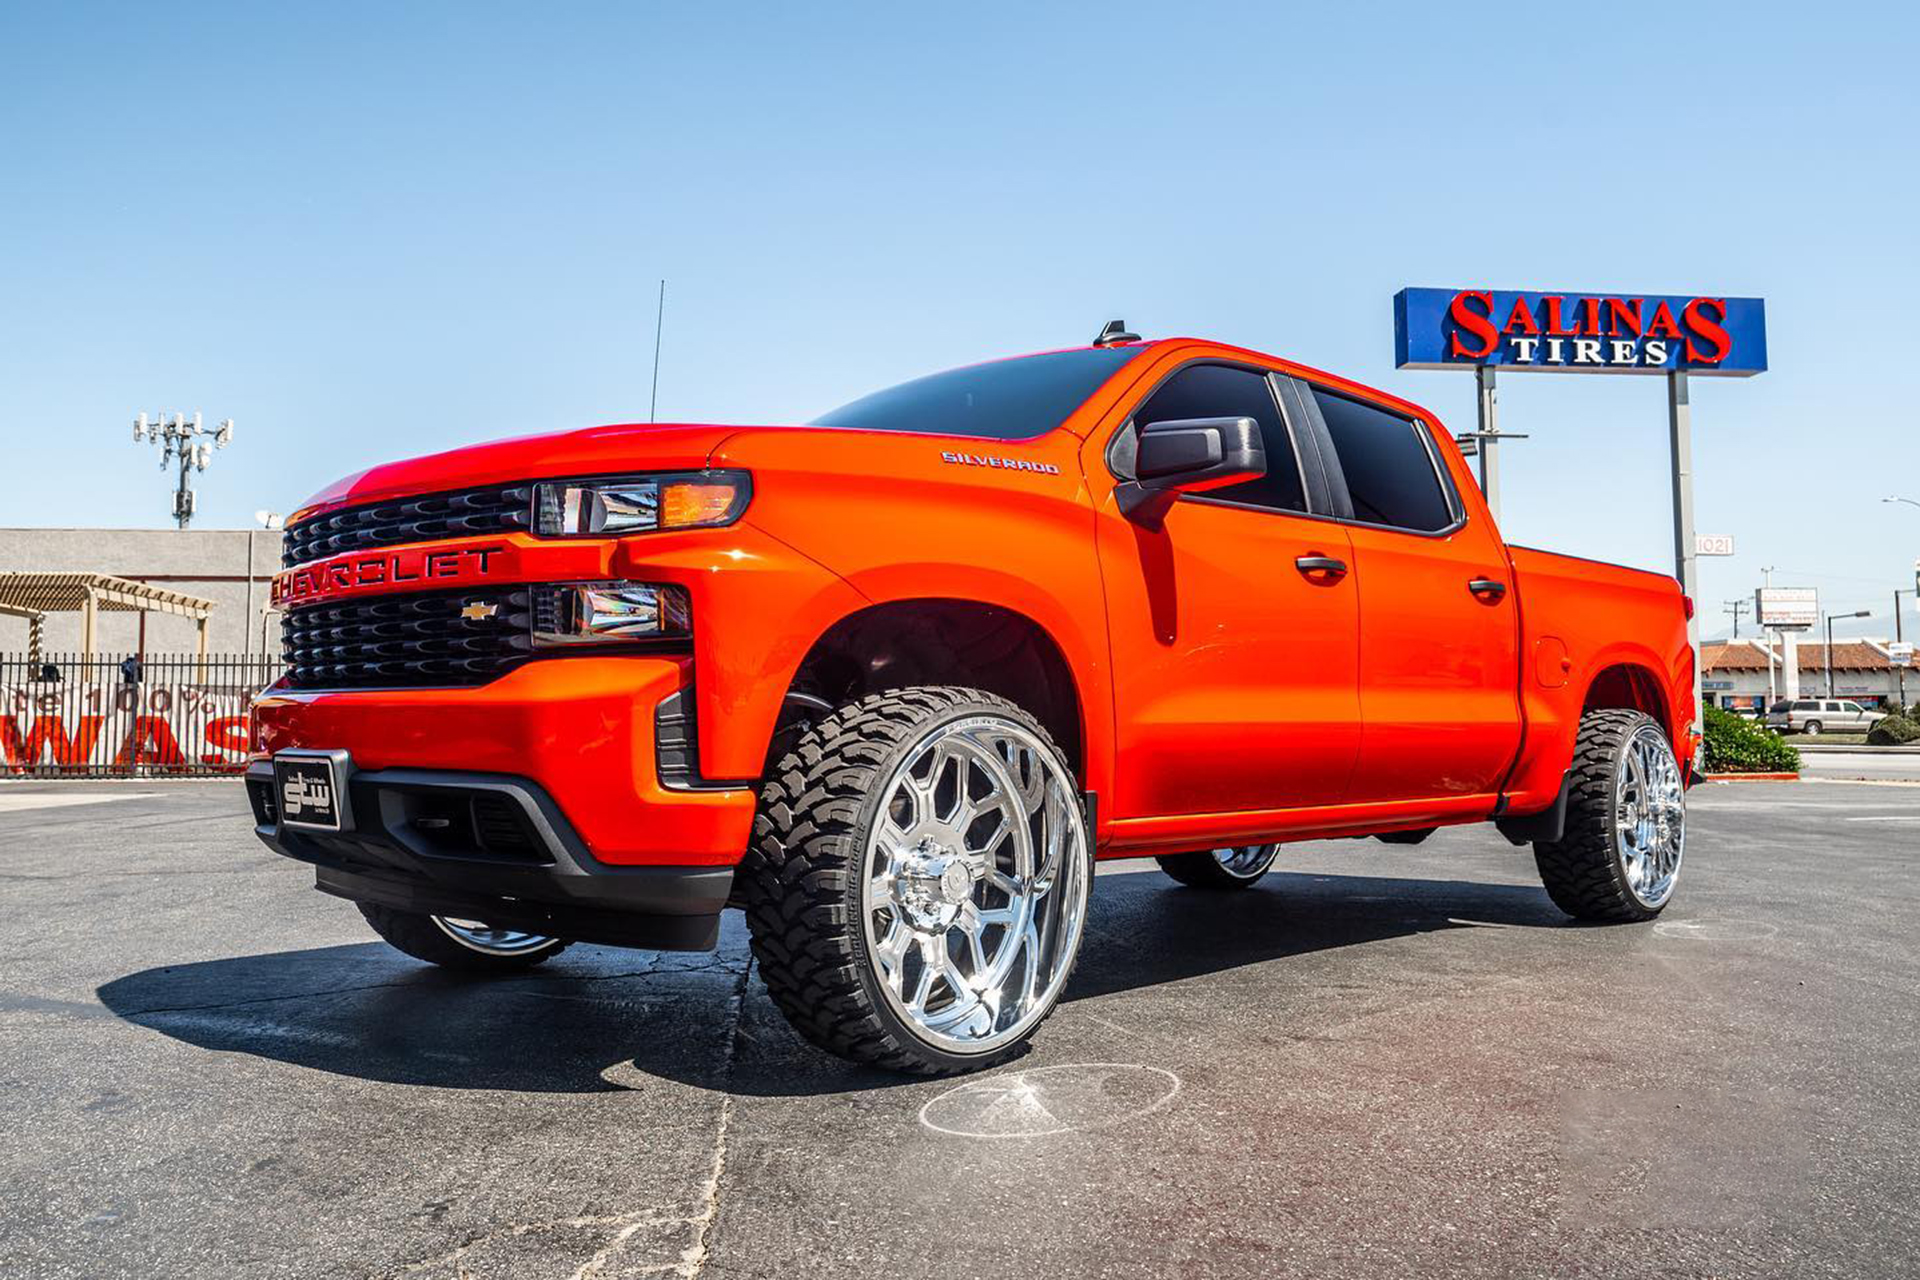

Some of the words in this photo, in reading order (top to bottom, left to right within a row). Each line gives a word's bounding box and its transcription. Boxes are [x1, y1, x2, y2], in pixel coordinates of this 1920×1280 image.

[1450, 290, 1732, 364] SALINAS
[1510, 337, 1668, 365] TIRES
[941, 451, 1059, 475] SILVERADO
[1698, 538, 1729, 554] 1021
[86, 688, 216, 714] 100%
